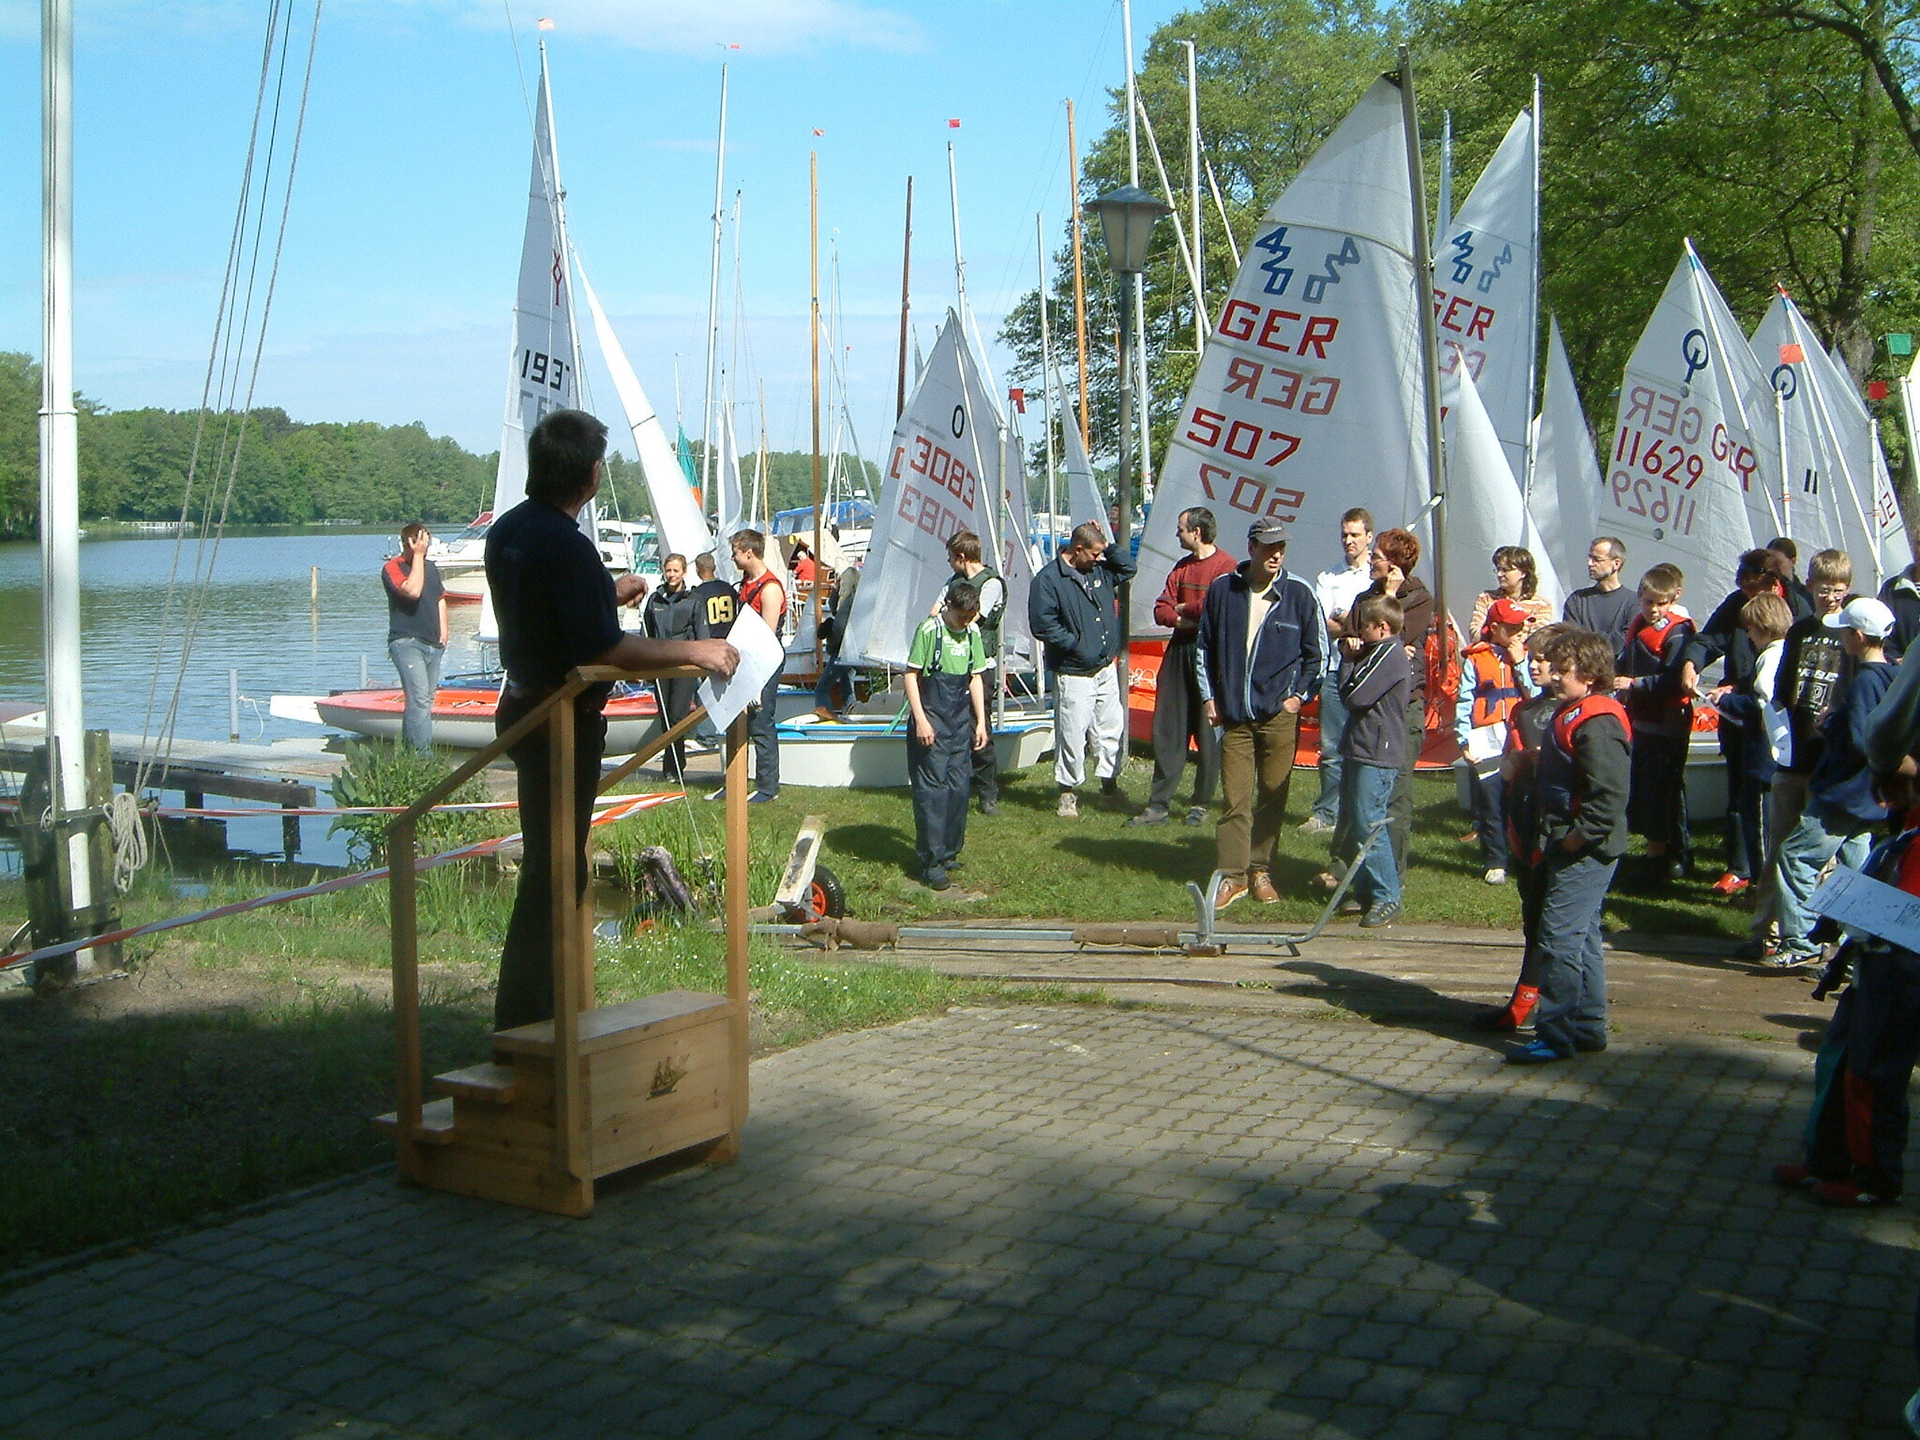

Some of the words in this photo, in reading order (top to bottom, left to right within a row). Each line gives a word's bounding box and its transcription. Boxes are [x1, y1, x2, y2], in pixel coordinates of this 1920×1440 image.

[1255, 227, 1294, 295] 420
[1452, 231, 1474, 284] 420
[1218, 299, 1340, 359] GER
[1186, 407, 1302, 467] 507
[1615, 426, 1704, 490] 11629
[706, 596, 734, 625] 09
